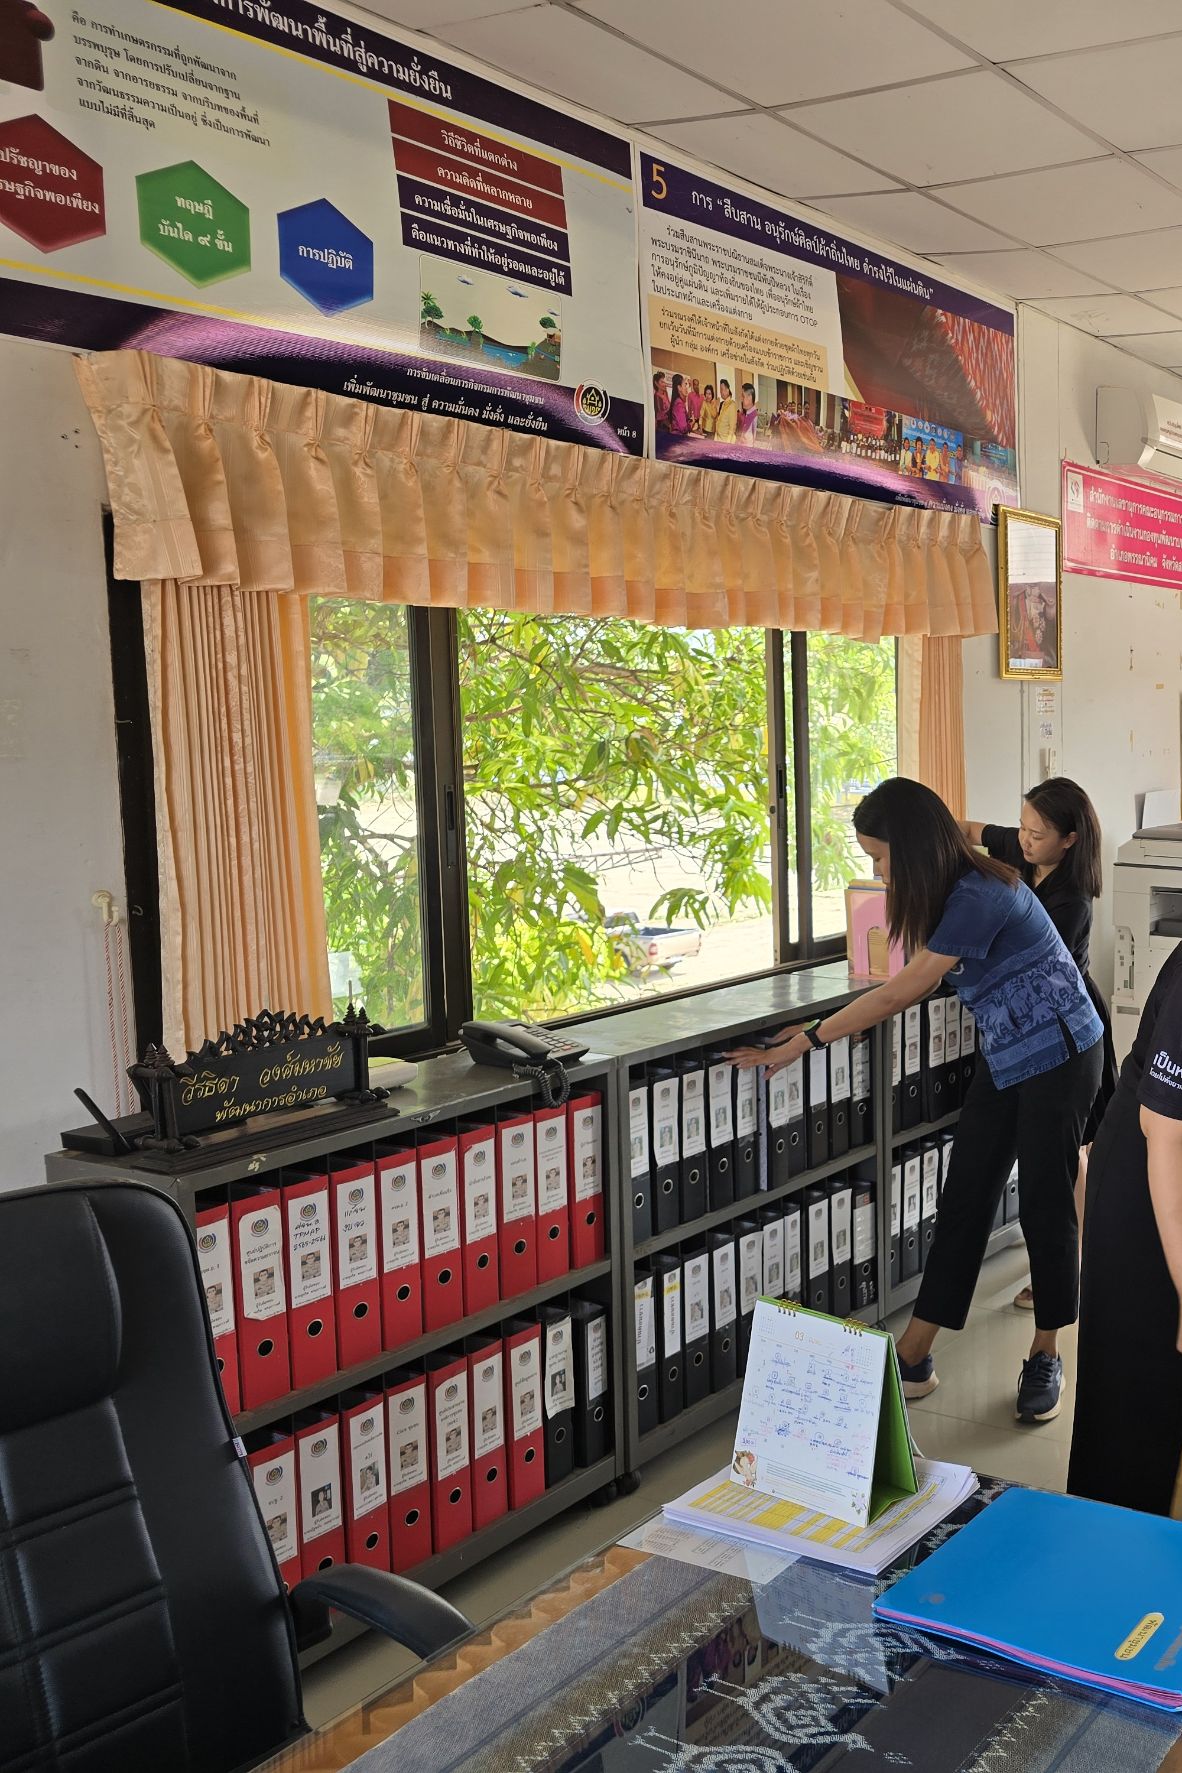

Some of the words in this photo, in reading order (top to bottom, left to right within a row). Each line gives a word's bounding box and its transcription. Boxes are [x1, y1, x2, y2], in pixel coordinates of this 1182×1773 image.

[71, 11, 87, 26] คือ
[75, 55, 109, 75] จากดิน
[441, 129, 518, 171] วิถีชีวิตที่แตกต่าง
[437, 166, 533, 209] ความคิดที่หลากหลาย
[651, 163, 667, 200] 5
[691, 190, 713, 211] การ
[158, 219, 193, 242] บันได
[198, 234, 211, 247] ๙
[215, 229, 233, 252] ขั้น
[414, 194, 558, 251] ความเชื่อมั่นในเศรษฐกิจพอเพียง
[298, 243, 353, 271] การปฏิบัติ
[411, 223, 565, 286] คือแนวทางที่ทำให้อยู่รอดและอยู่ได้
[432, 397, 479, 417] ความมั่นคง
[482, 403, 505, 422] มั่งคั่ง
[508, 411, 548, 431] และยั่งยืน
[215, 1085, 327, 1122] พัฒนาการอำเภอ
